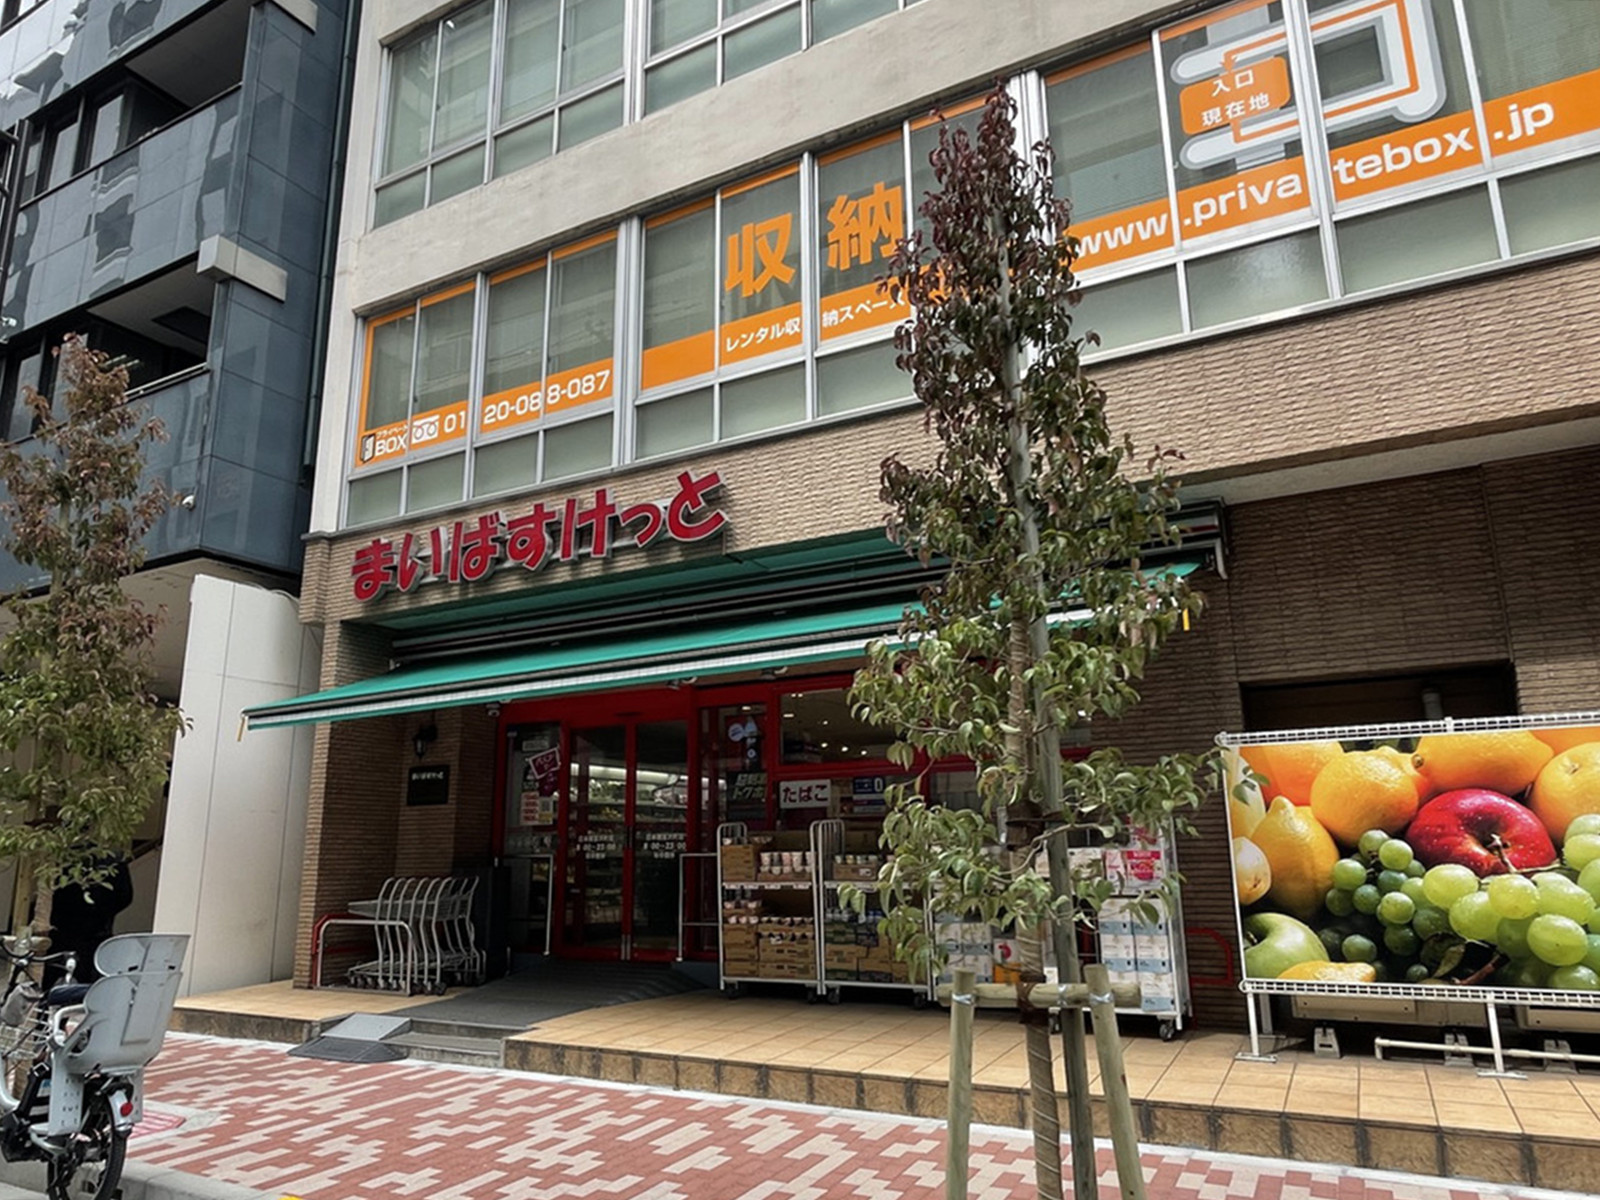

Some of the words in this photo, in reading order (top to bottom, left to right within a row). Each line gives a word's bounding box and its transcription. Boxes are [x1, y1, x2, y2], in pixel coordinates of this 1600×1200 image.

[1210, 68, 1255, 97] 入口
[1200, 92, 1271, 128] 現在地
[375, 432, 409, 457] BOX
[351, 470, 730, 601] まいばすけっと
[782, 784, 829, 803] たばこ
